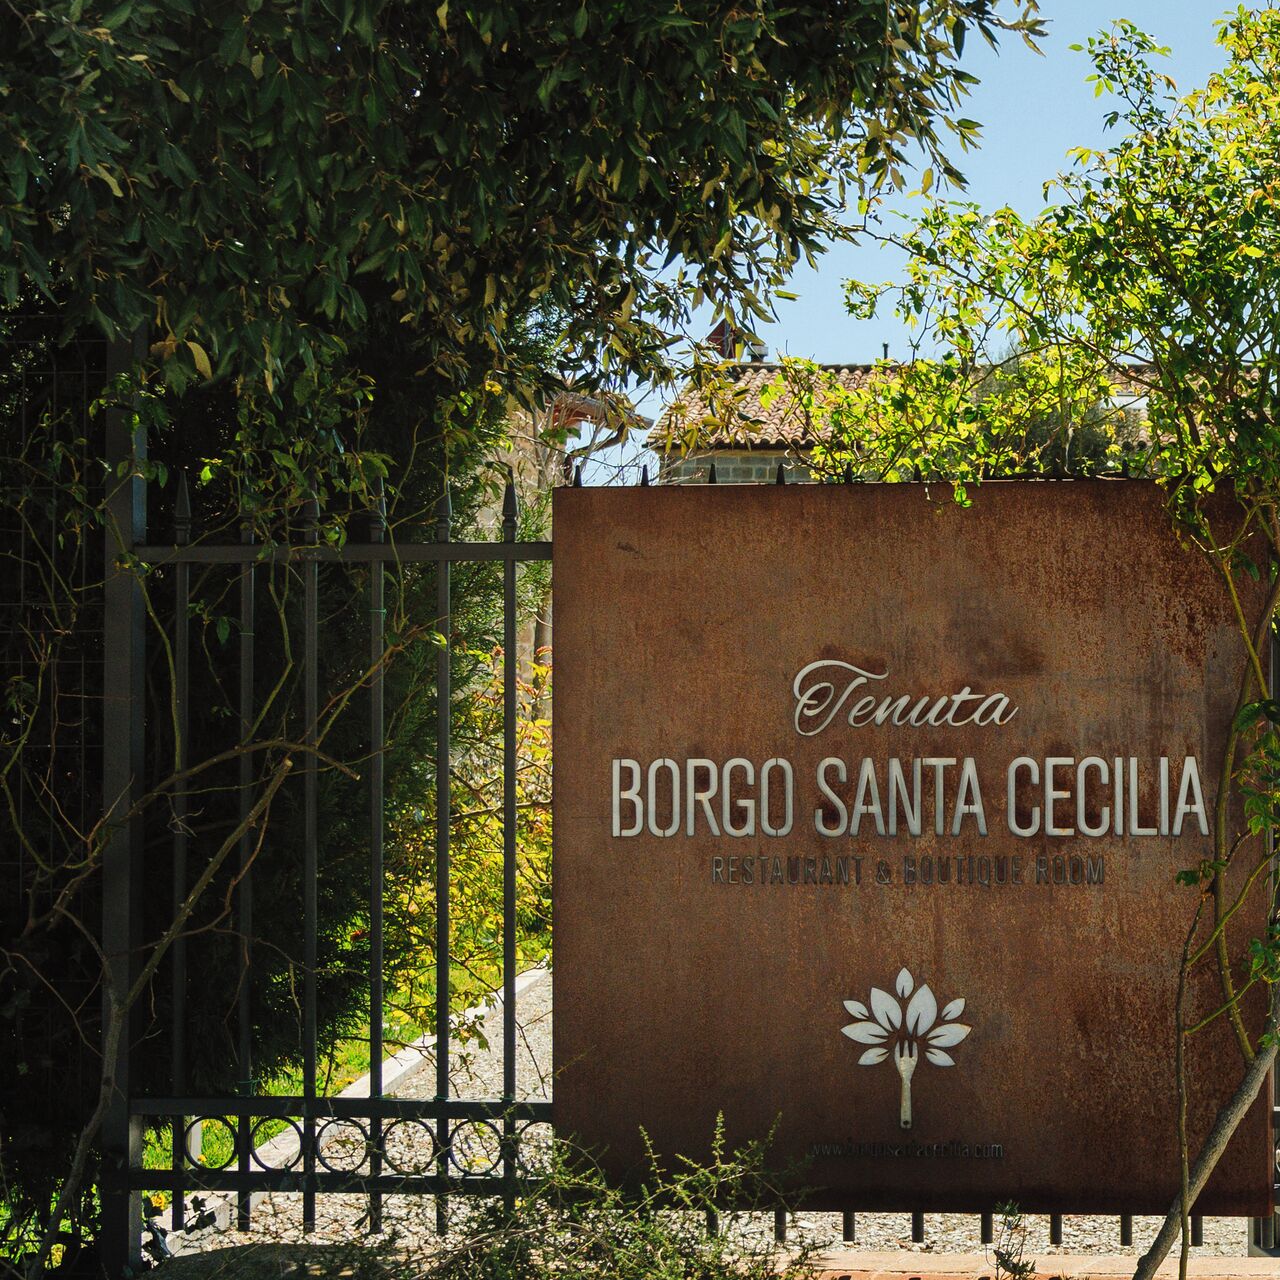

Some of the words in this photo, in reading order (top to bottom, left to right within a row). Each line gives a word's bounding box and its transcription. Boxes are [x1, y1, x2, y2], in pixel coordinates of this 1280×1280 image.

[794, 659, 1019, 736] Tenuta
[612, 758, 794, 838] BORGO
[814, 757, 988, 837] SANTA
[1007, 756, 1209, 836] CECILIA
[711, 856, 864, 885] RESTAURANT
[875, 858, 893, 885] &
[903, 856, 1022, 888] BOUTIQUE
[1036, 856, 1105, 885] ROOM
